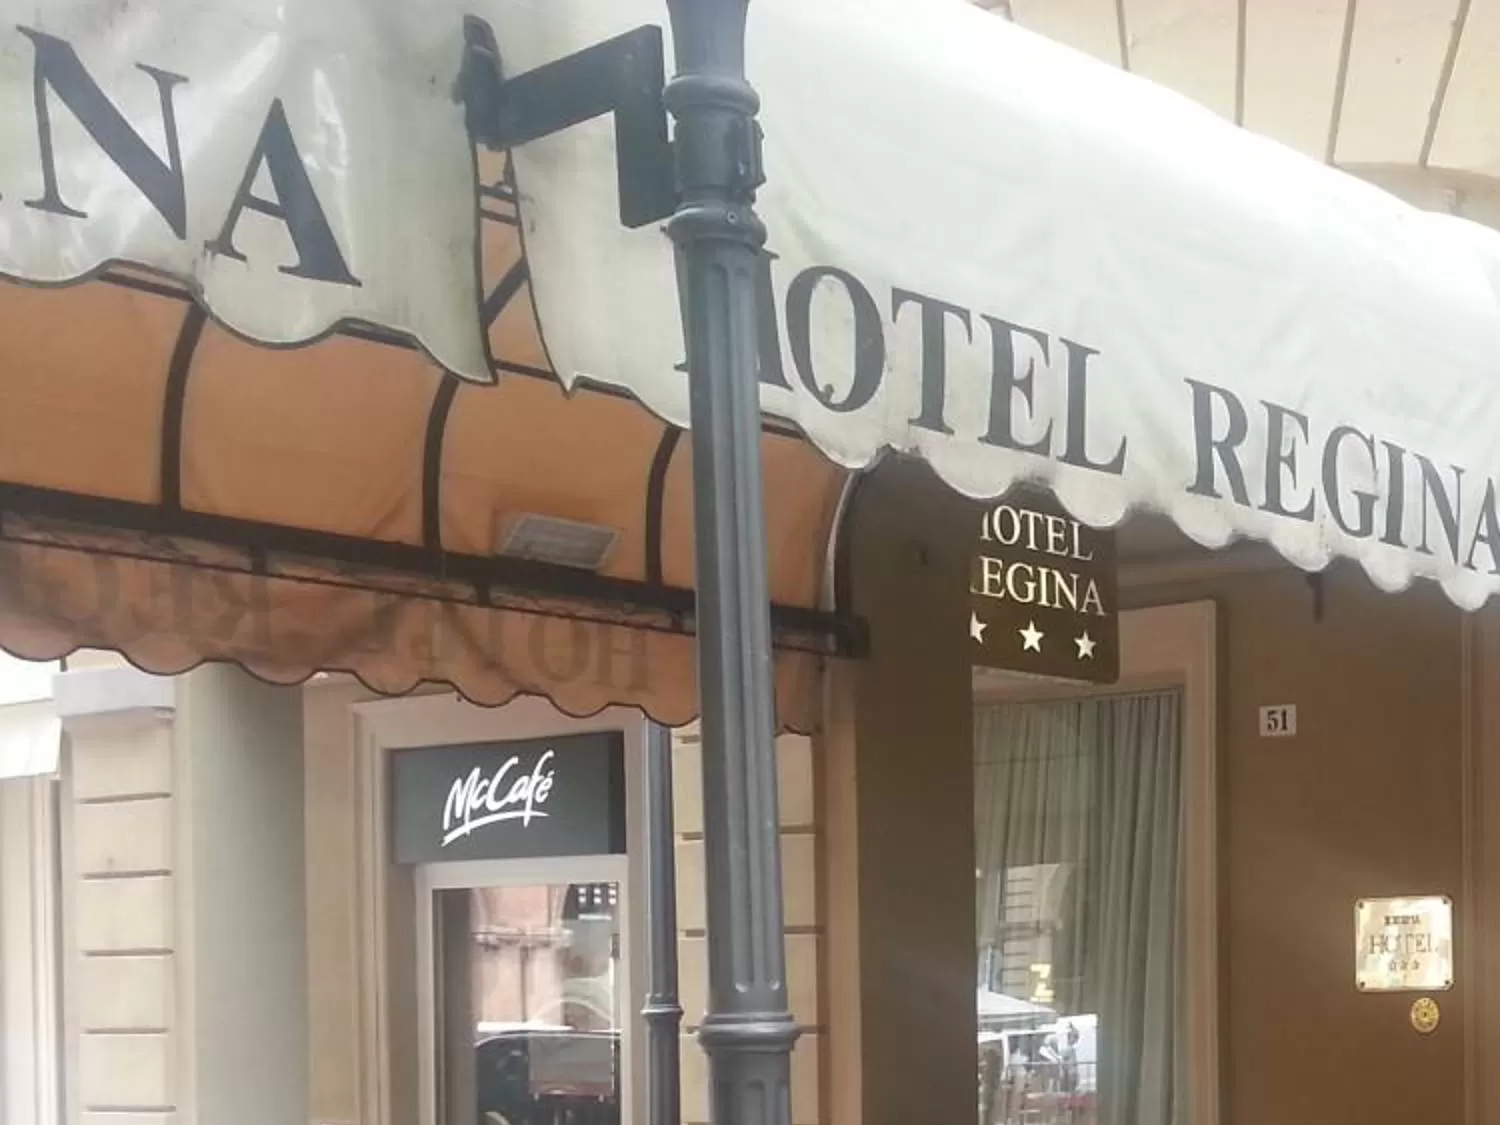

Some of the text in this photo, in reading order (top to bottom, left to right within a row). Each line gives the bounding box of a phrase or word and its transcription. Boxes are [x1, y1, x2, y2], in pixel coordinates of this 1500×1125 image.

[970, 554, 1110, 617] EGINA
[1266, 708, 1289, 732] 51
[441, 748, 555, 847] McCafé
